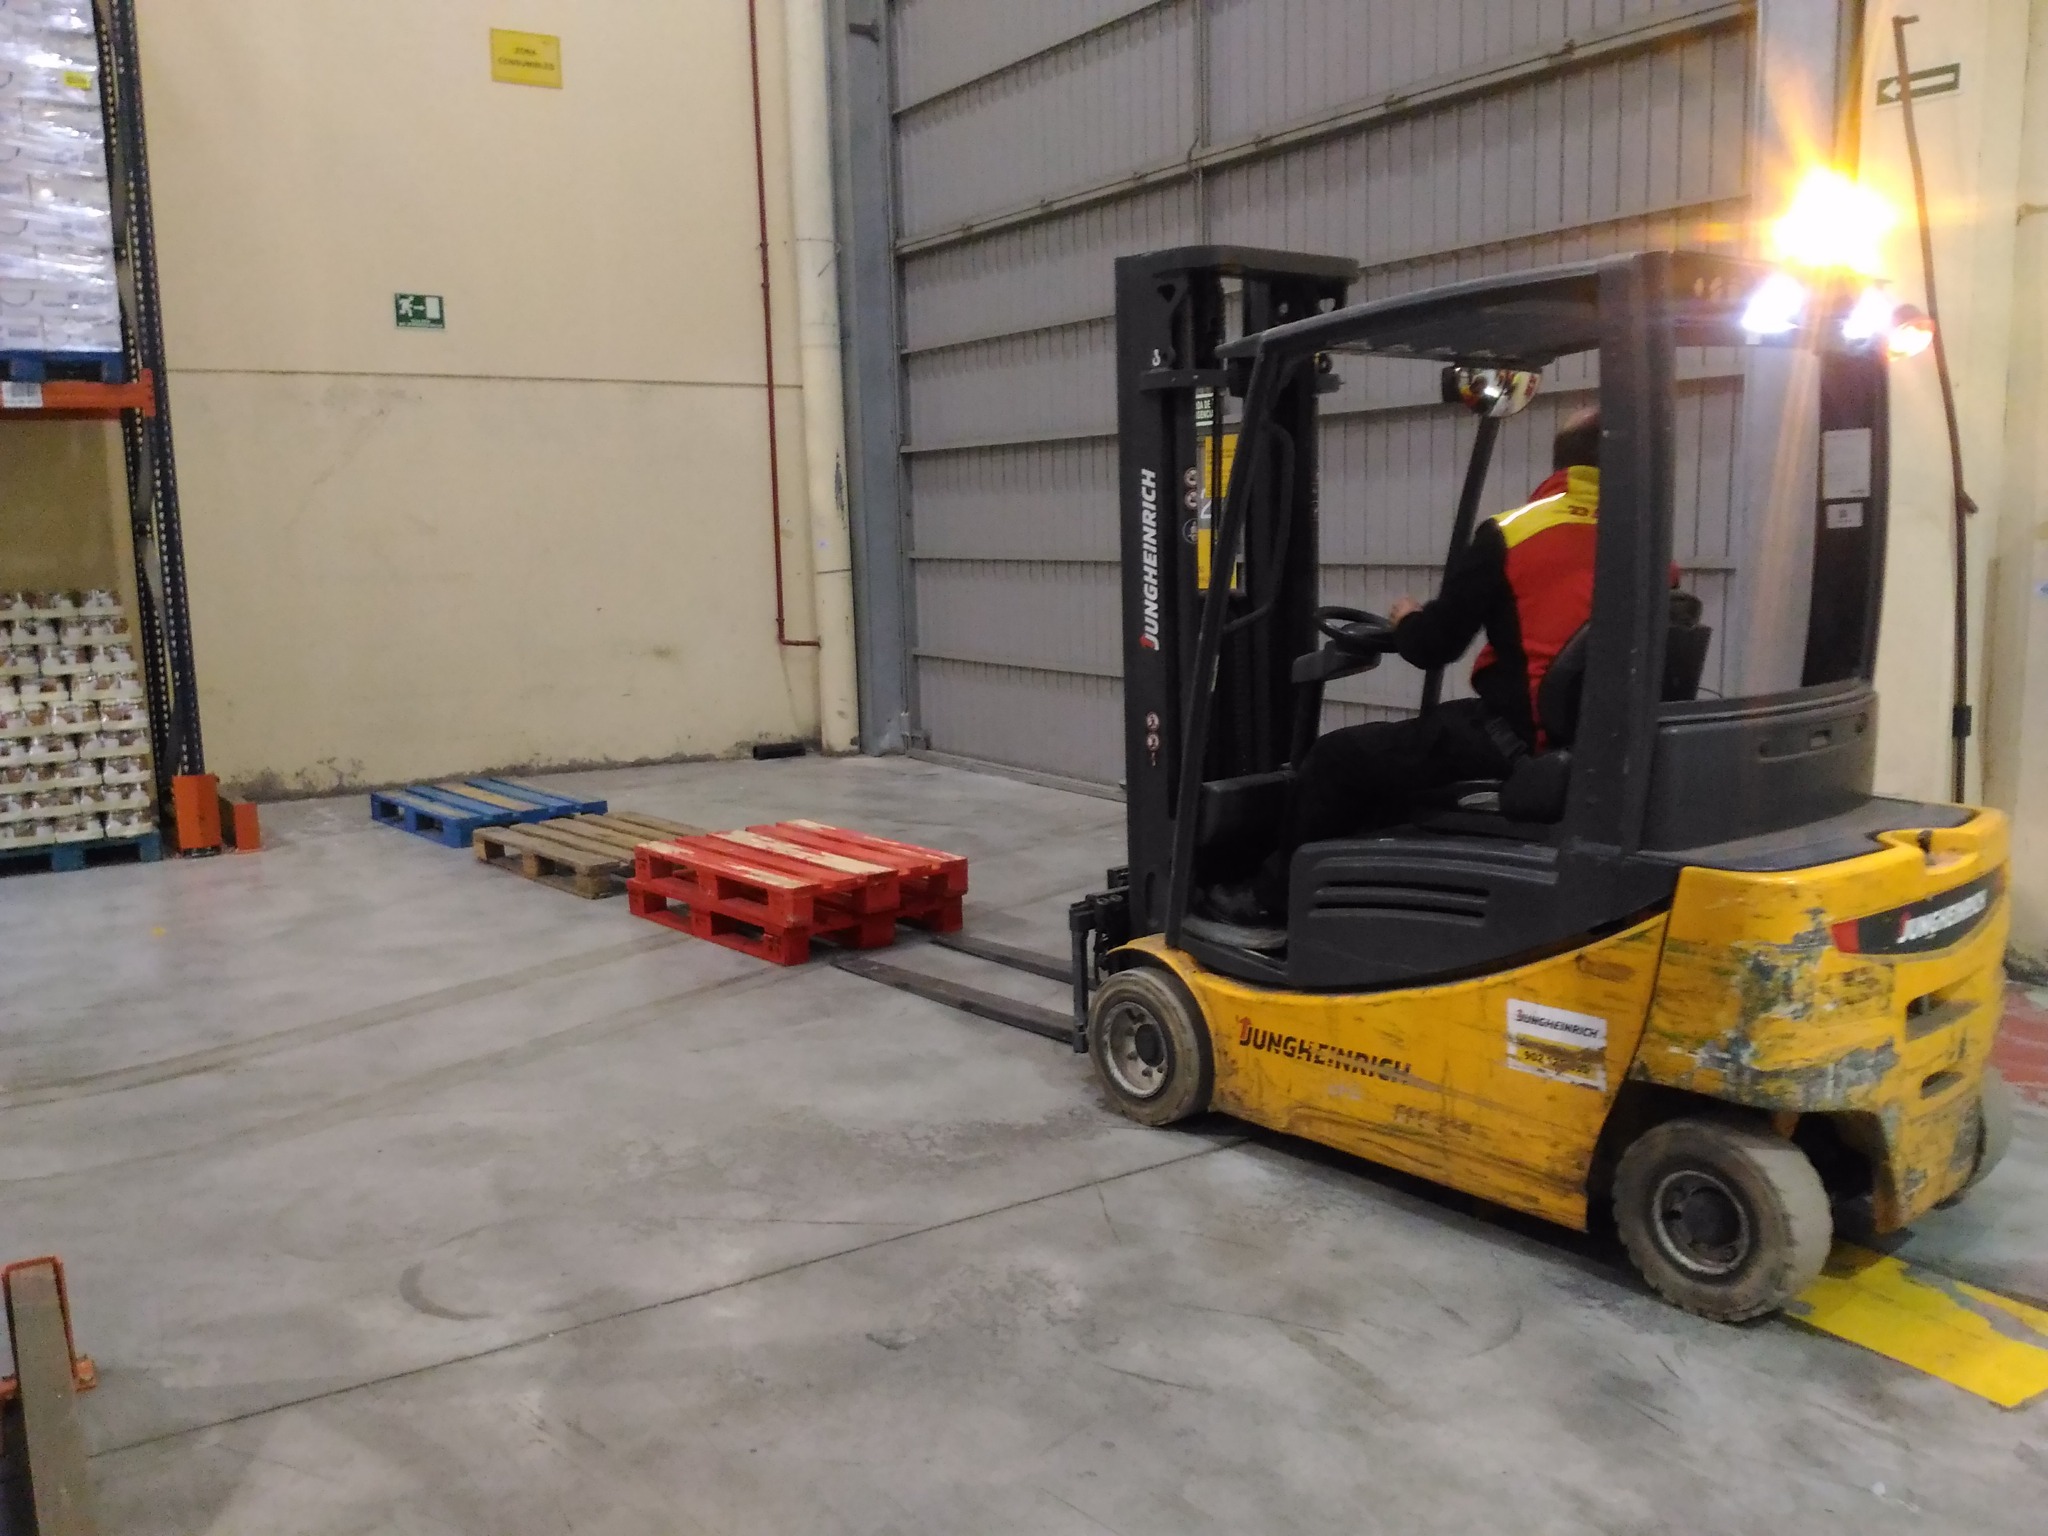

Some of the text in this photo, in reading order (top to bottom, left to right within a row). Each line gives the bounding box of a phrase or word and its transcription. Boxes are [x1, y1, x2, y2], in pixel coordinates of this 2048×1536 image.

[1140, 469, 1160, 651] JUNGHEINRICH
[1239, 1018, 1412, 1085] JUNGHEINRICH
[1515, 1009, 1600, 1039] JUNGHEINRICH
